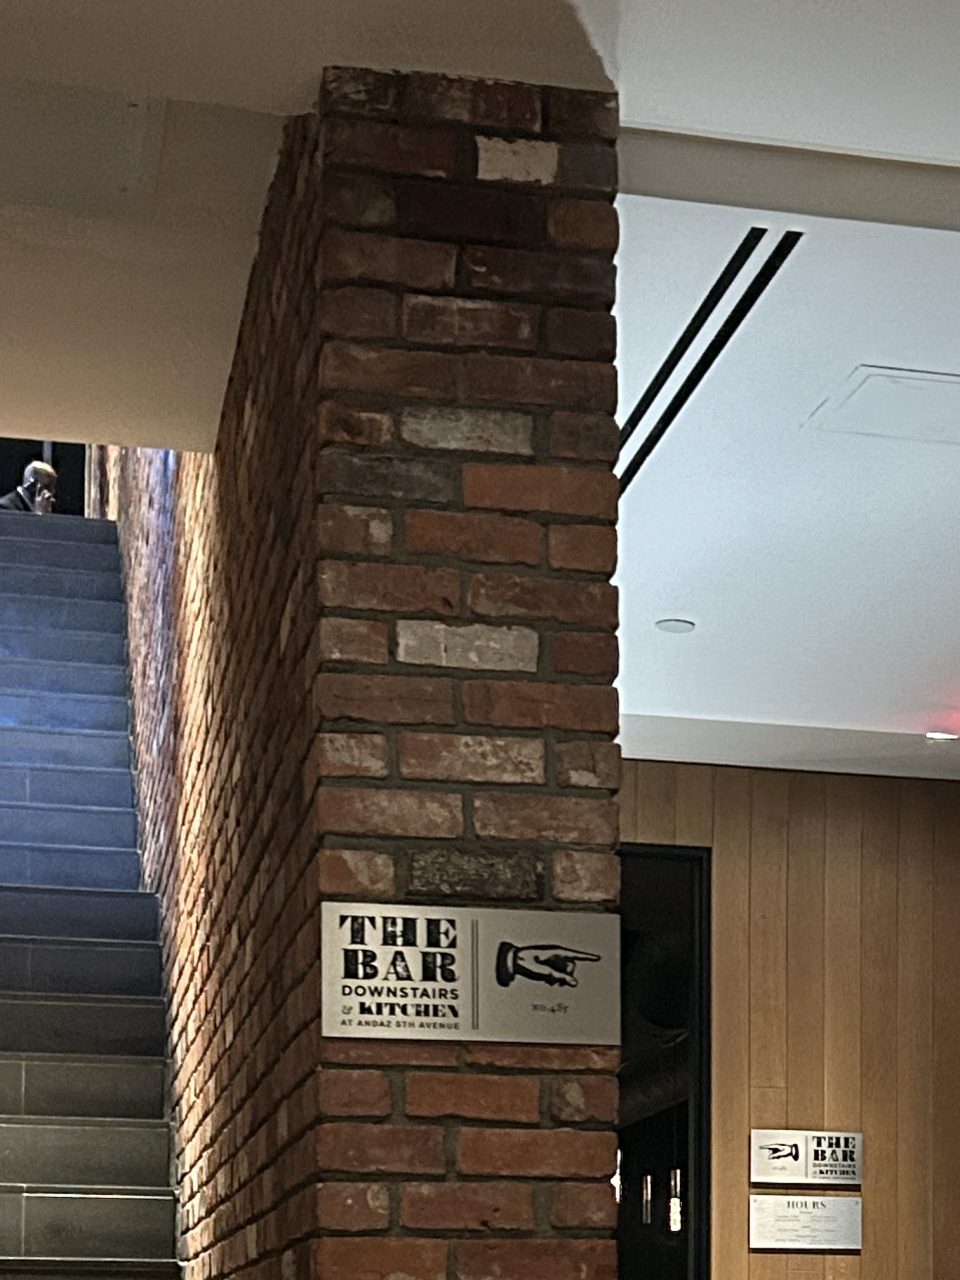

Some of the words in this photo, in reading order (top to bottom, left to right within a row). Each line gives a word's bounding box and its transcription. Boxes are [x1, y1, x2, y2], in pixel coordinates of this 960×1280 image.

[339, 915, 457, 949] THE
[341, 948, 459, 983] BAR
[341, 985, 459, 1000] DOWNSTAIRS
[358, 1002, 459, 1018] KITCHEN
[357, 1020, 392, 1028] ANDAZ
[419, 1022, 460, 1031] AVENUE
[812, 1136, 856, 1149] THE
[813, 1149, 856, 1162] BAR
[786, 1200, 827, 1209] HOURS
